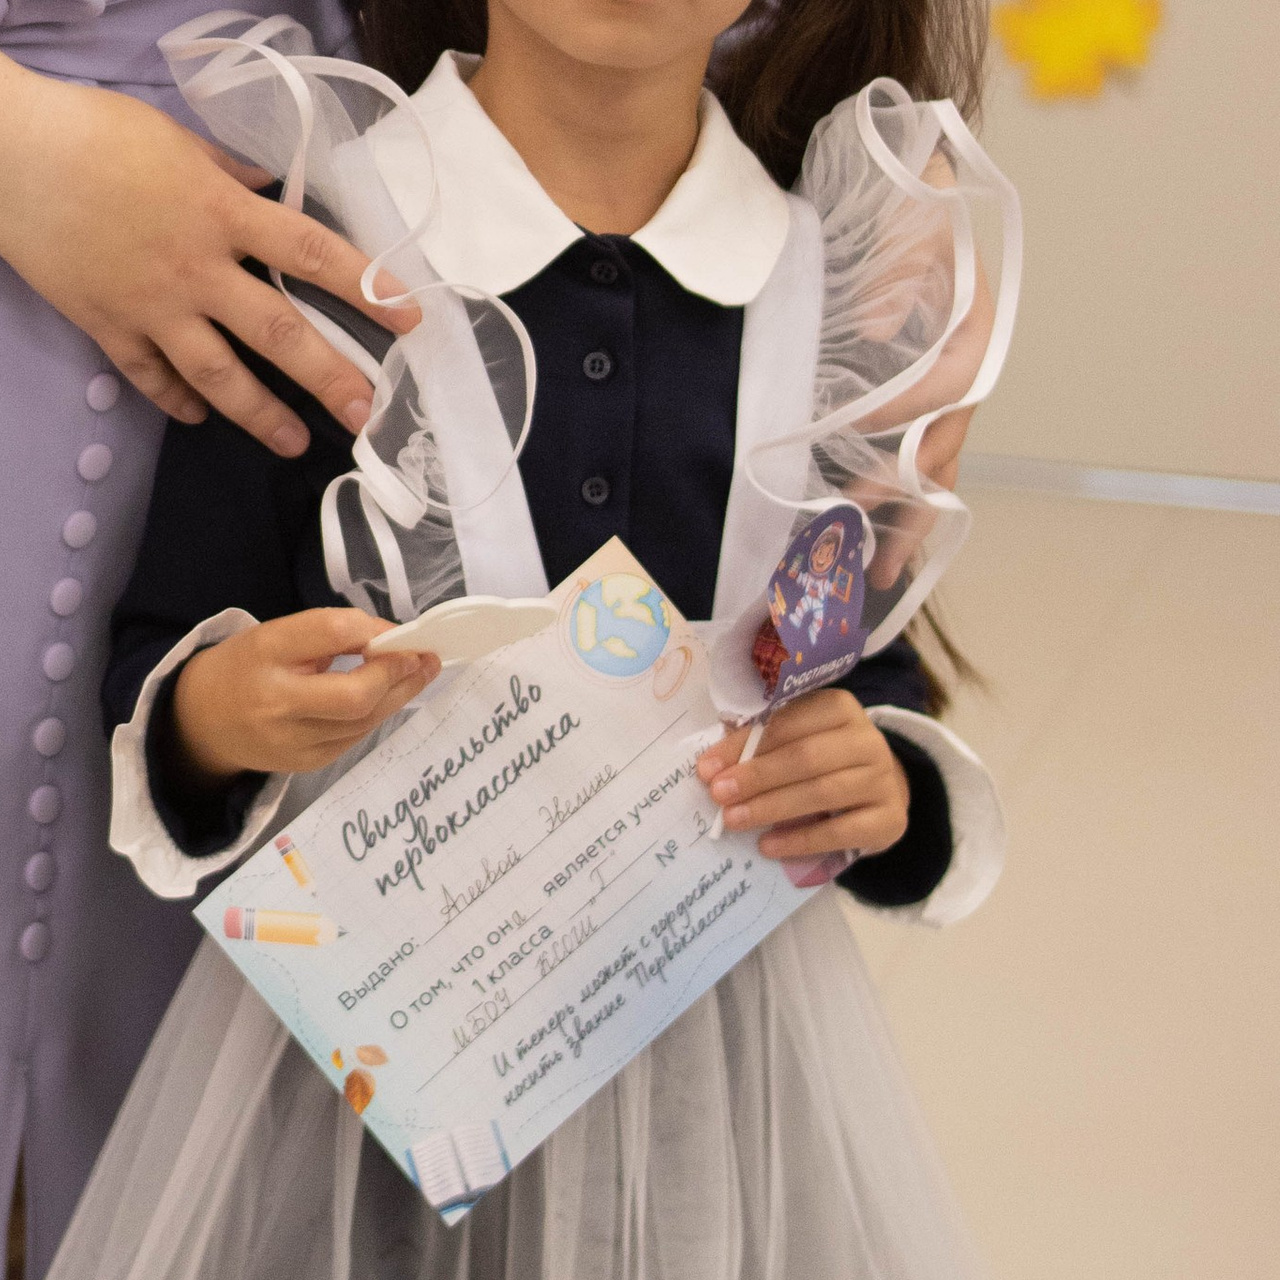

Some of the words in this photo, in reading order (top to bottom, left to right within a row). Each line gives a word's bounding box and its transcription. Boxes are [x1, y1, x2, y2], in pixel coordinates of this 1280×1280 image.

[342, 674, 542, 861] Свидетельство
[375, 712, 580, 896] первоклассника
[389, 1009, 409, 1030] О
[409, 978, 453, 1015] том,
[451, 945, 485, 976] что
[543, 819, 628, 898] является
[654, 839, 679, 868] №
[337, 936, 420, 1011] Выдано:
[472, 979, 487, 993] 1
[487, 924, 554, 985] класса
[493, 1051, 515, 1078] И
[516, 1003, 575, 1061] теперь
[580, 944, 637, 1003] может
[640, 934, 651, 949] с
[651, 858, 733, 938] гордостью
[505, 1052, 563, 1106] носить
[566, 993, 626, 1059] звание
